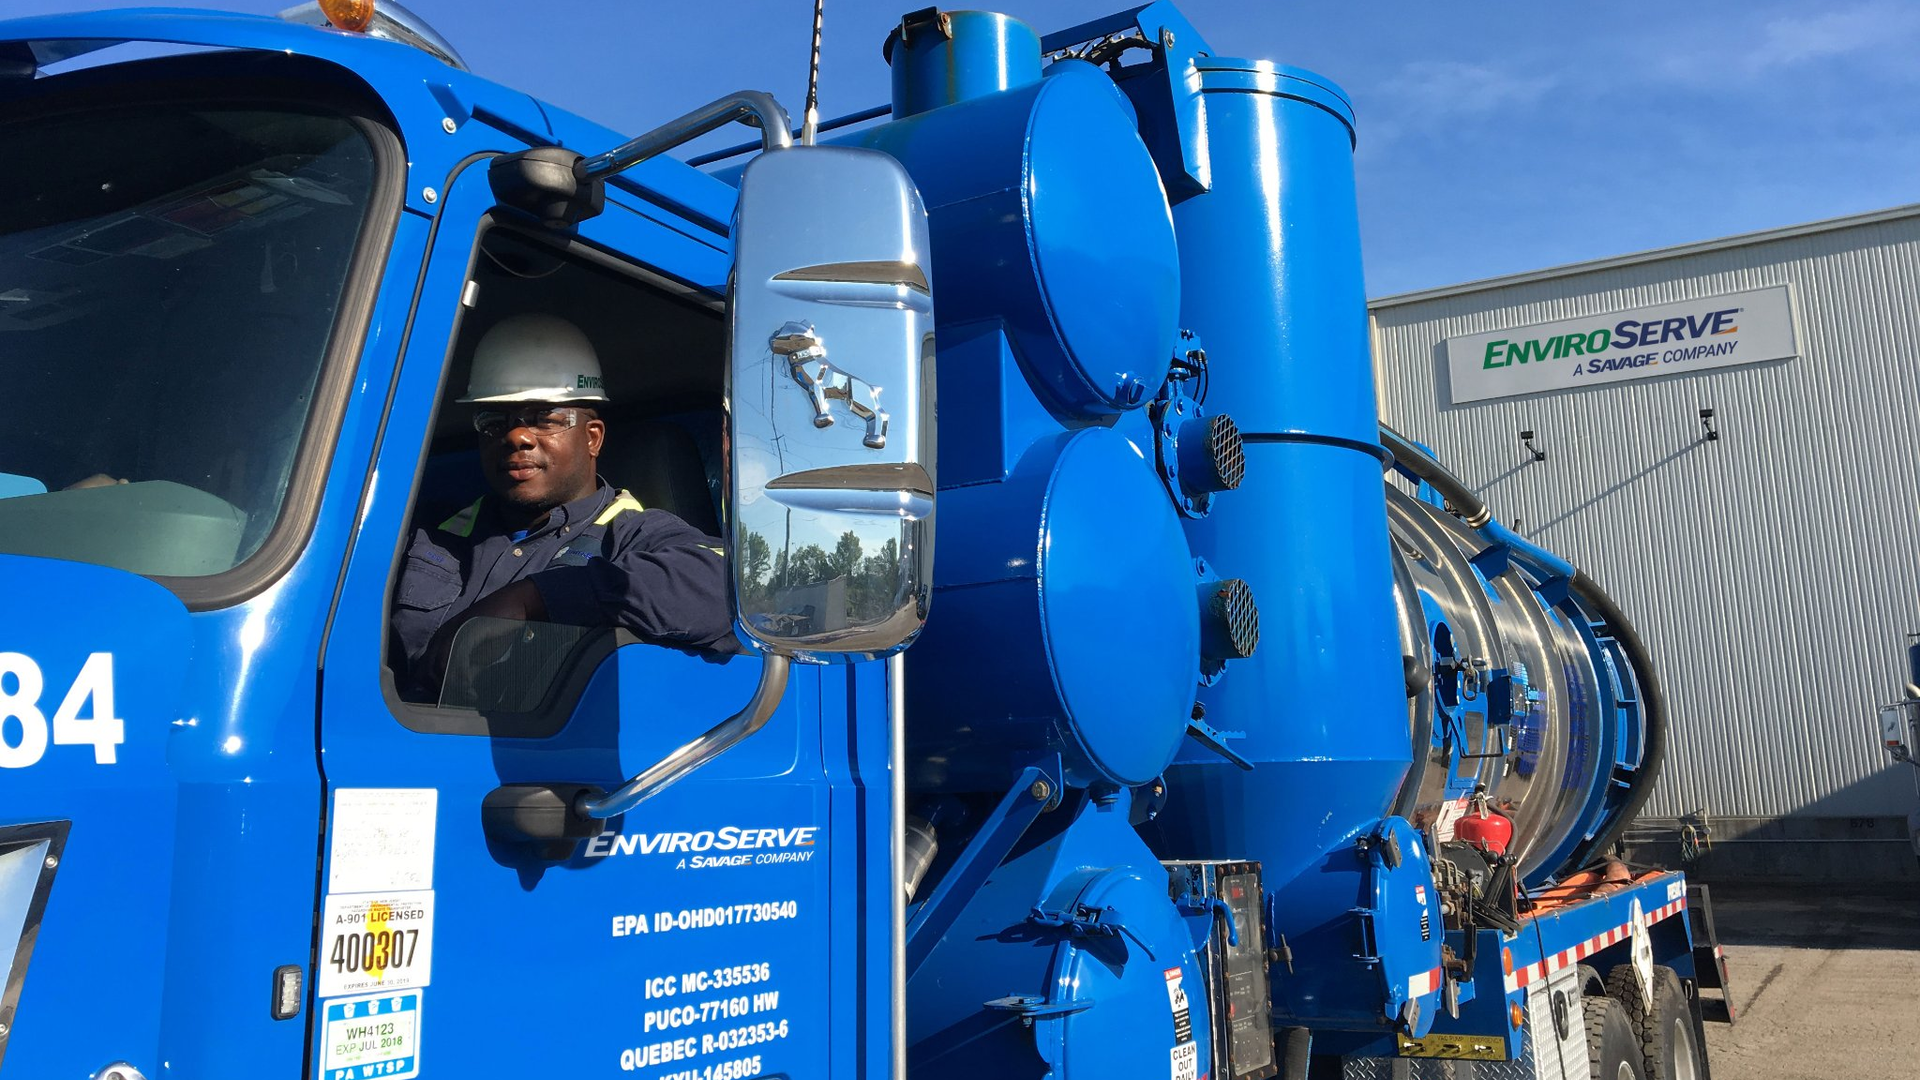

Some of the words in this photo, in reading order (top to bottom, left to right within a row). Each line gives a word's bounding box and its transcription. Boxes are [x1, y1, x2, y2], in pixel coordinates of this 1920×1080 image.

[1483, 308, 1738, 370] ENVIROSERVE
[1573, 364, 1583, 377] A
[1587, 352, 1658, 374] SAVAGE
[1663, 340, 1738, 364] COMPANY
[584, 826, 817, 858] ENVIROSERVE
[676, 859, 686, 870] A
[690, 854, 753, 869] SAVAGE
[755, 851, 815, 864] COMPANY
[336, 913, 366, 925] A-901
[370, 909, 424, 923] LICENSED
[612, 914, 649, 937] EPA
[654, 900, 797, 932] ID-OHD017730540
[330, 929, 419, 974] 400307
[645, 976, 677, 999] ICC
[682, 962, 770, 994] MC-335536
[643, 996, 749, 1033] PUCO-77160
[753, 990, 779, 1013] HW
[336, 1042, 356, 1056] EXP
[359, 1040, 377, 1052] JUL
[380, 1035, 403, 1048] 2018
[346, 1022, 394, 1041] WH4123
[620, 1036, 698, 1071] QUEBEC
[701, 1019, 789, 1055] R-032353-6
[1173, 1044, 1195, 1060] CLEAN
[1178, 1058, 1192, 1071] OUT
[335, 1068, 355, 1080] PA
[362, 1059, 405, 1077] WTSP
[659, 1055, 762, 1080] U-145805
